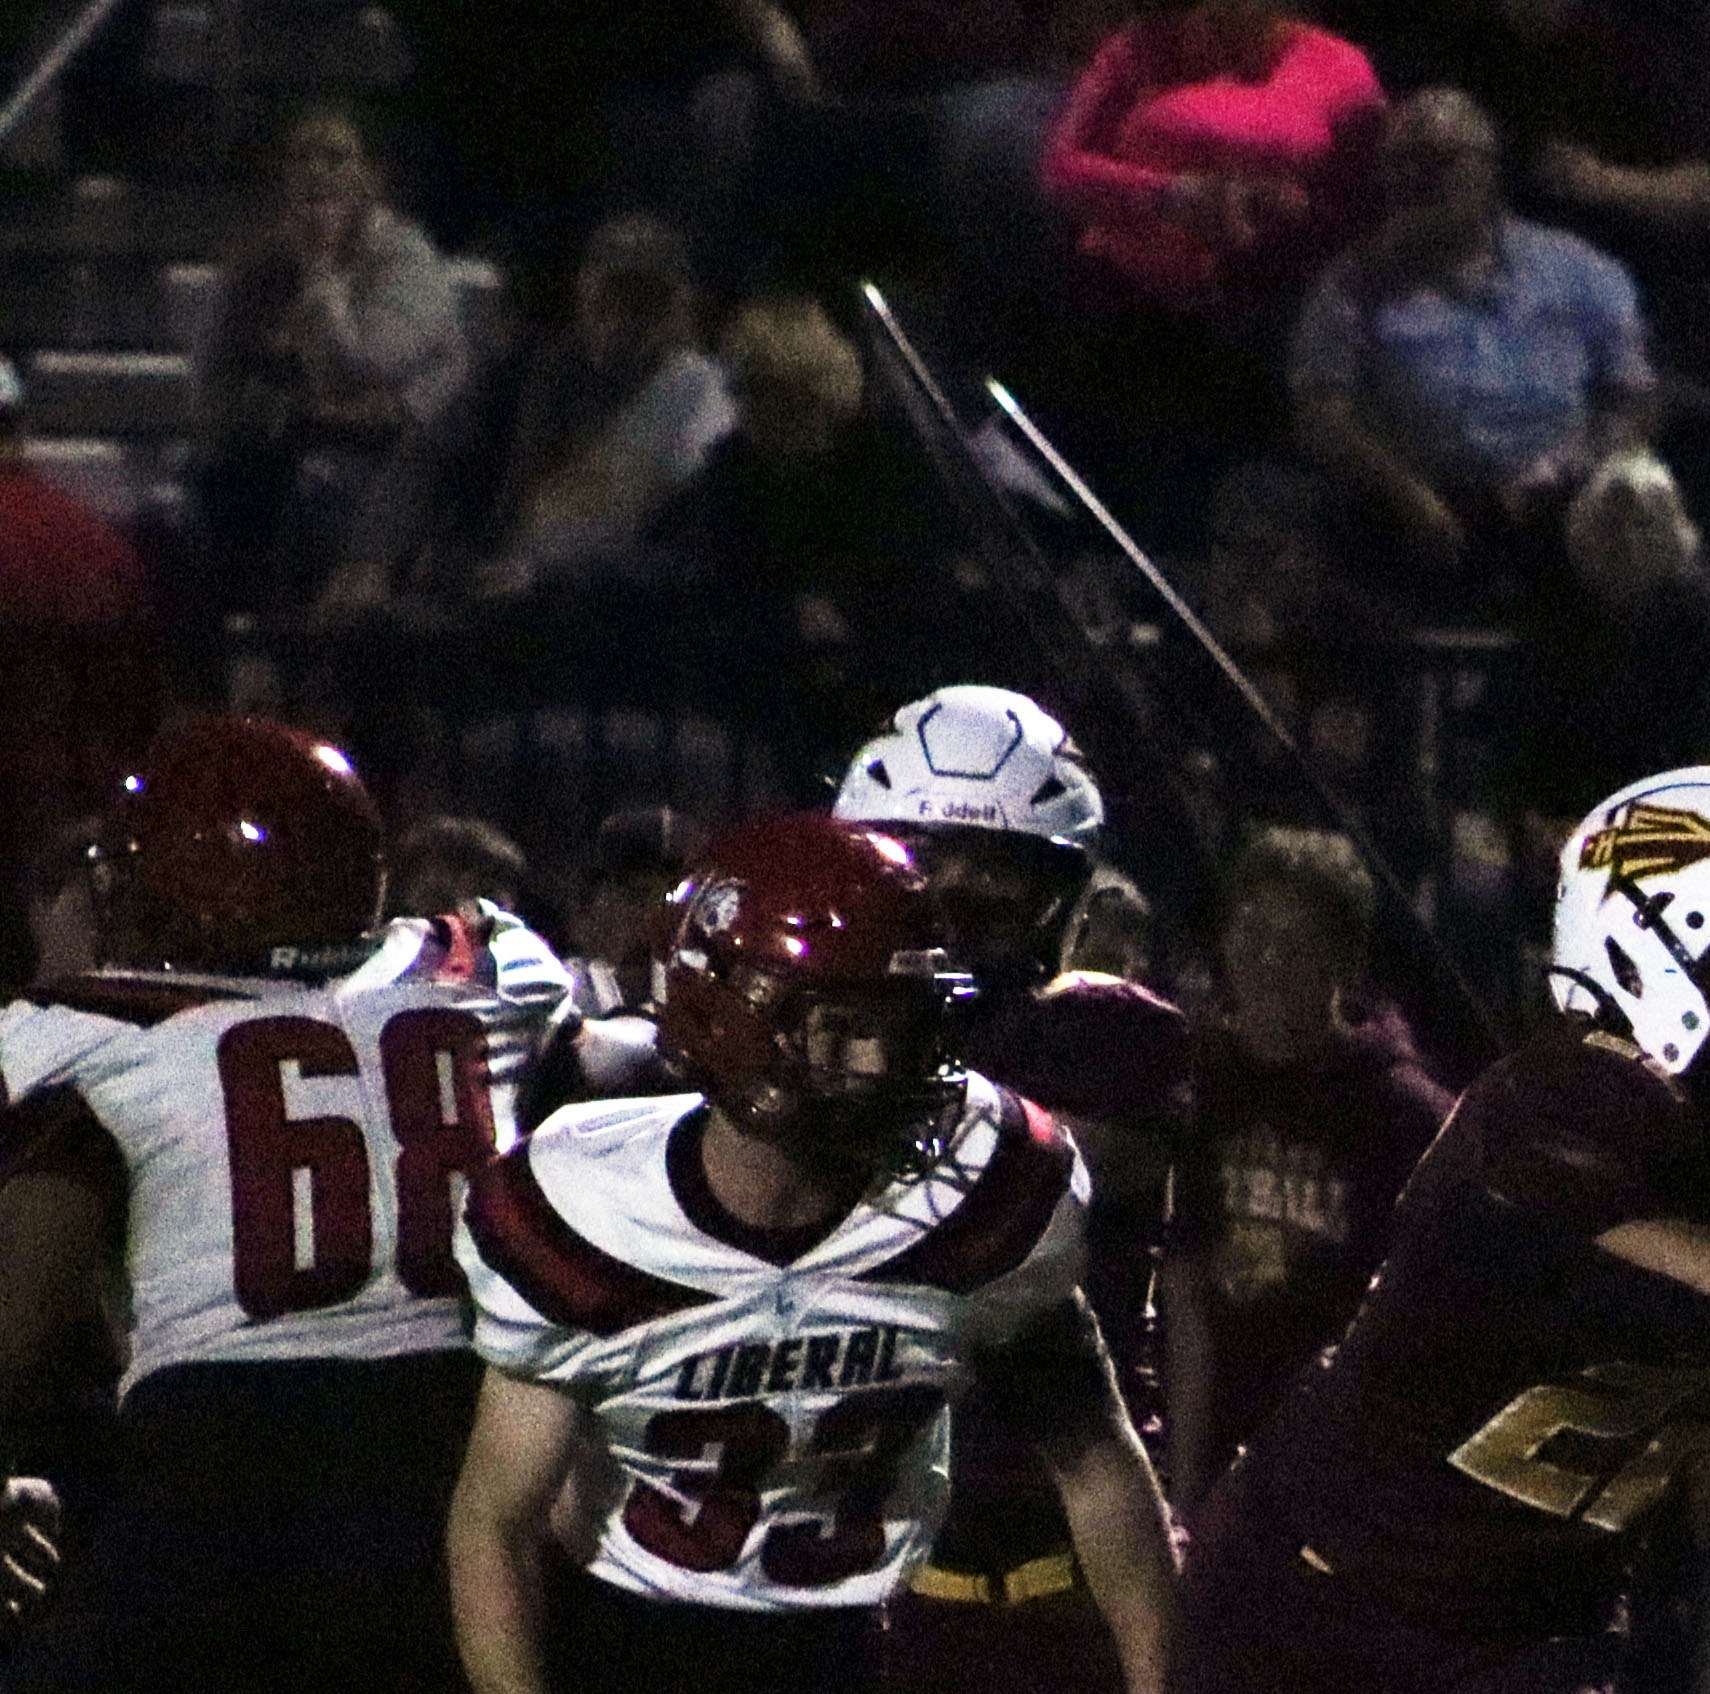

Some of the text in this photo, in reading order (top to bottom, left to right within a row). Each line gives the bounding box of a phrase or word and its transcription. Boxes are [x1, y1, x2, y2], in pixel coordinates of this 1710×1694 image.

[217, 1007, 497, 1324] 68
[675, 1325, 901, 1401] LIBERAL
[624, 1383, 946, 1588] 33
